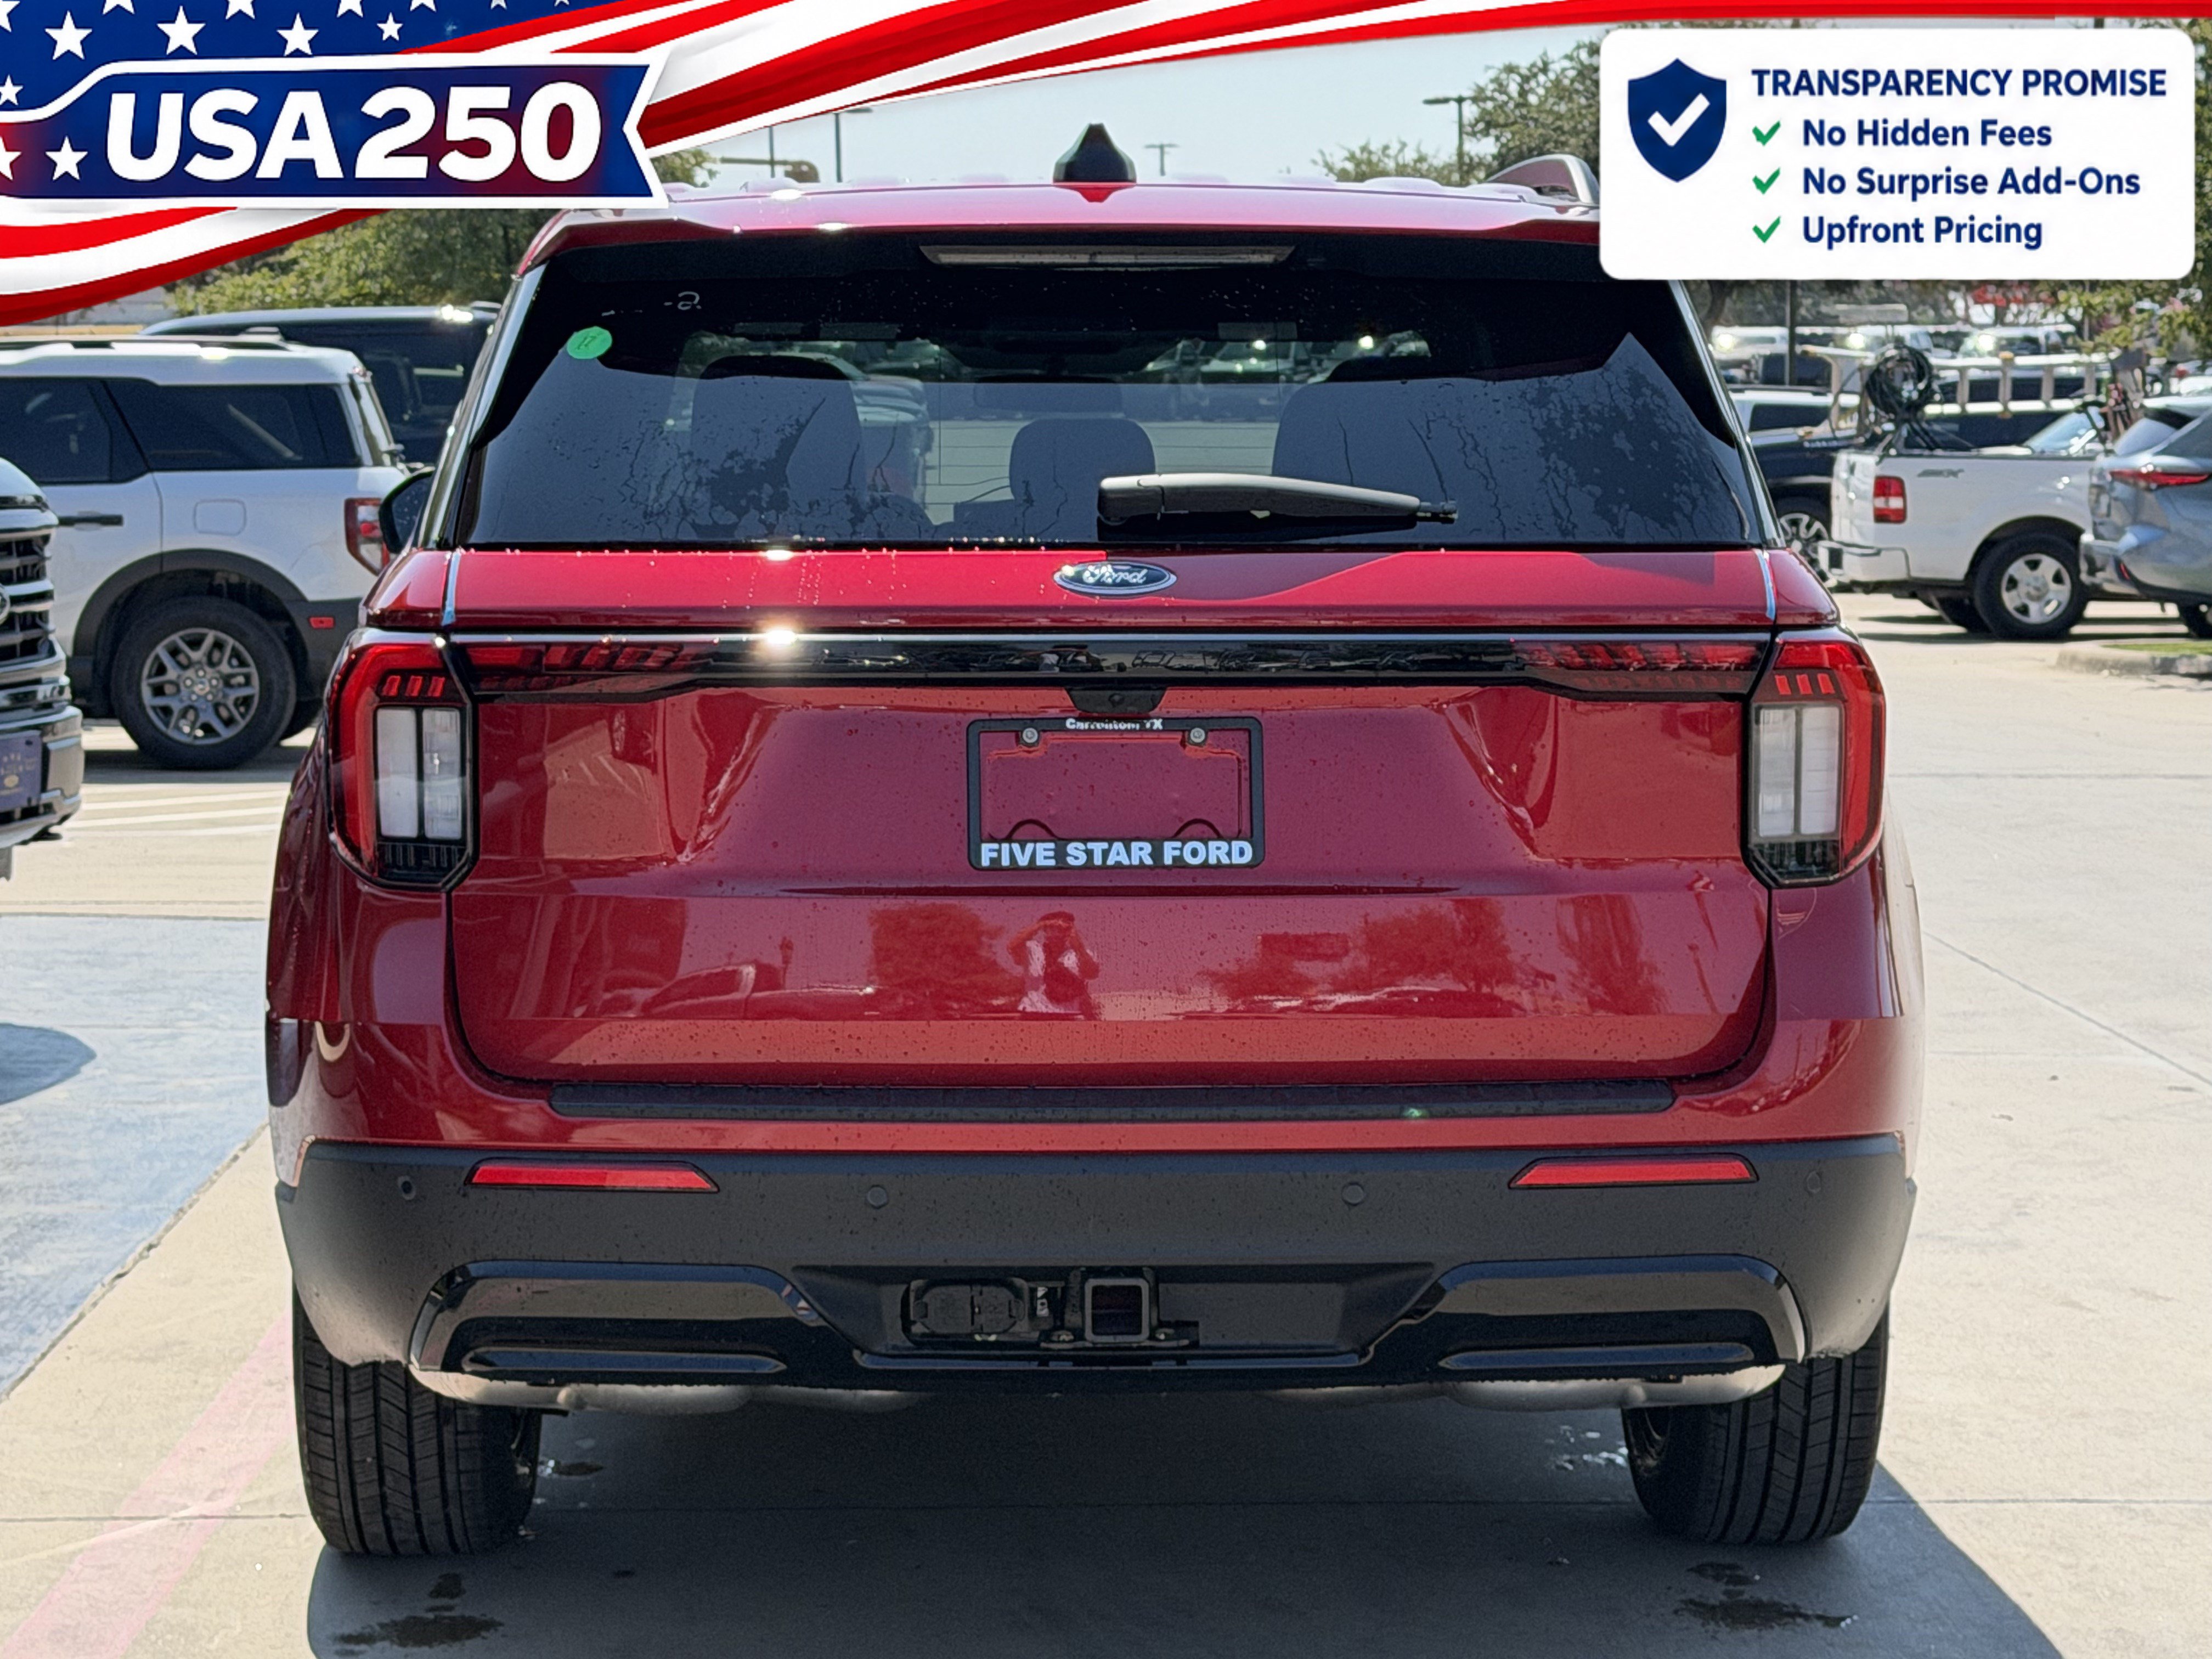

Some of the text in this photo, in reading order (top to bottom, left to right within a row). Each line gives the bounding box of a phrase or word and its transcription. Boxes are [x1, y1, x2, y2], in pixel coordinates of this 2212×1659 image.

[1082, 564, 1148, 584] Ford
[981, 840, 1253, 867] FIVE STAR FORD
